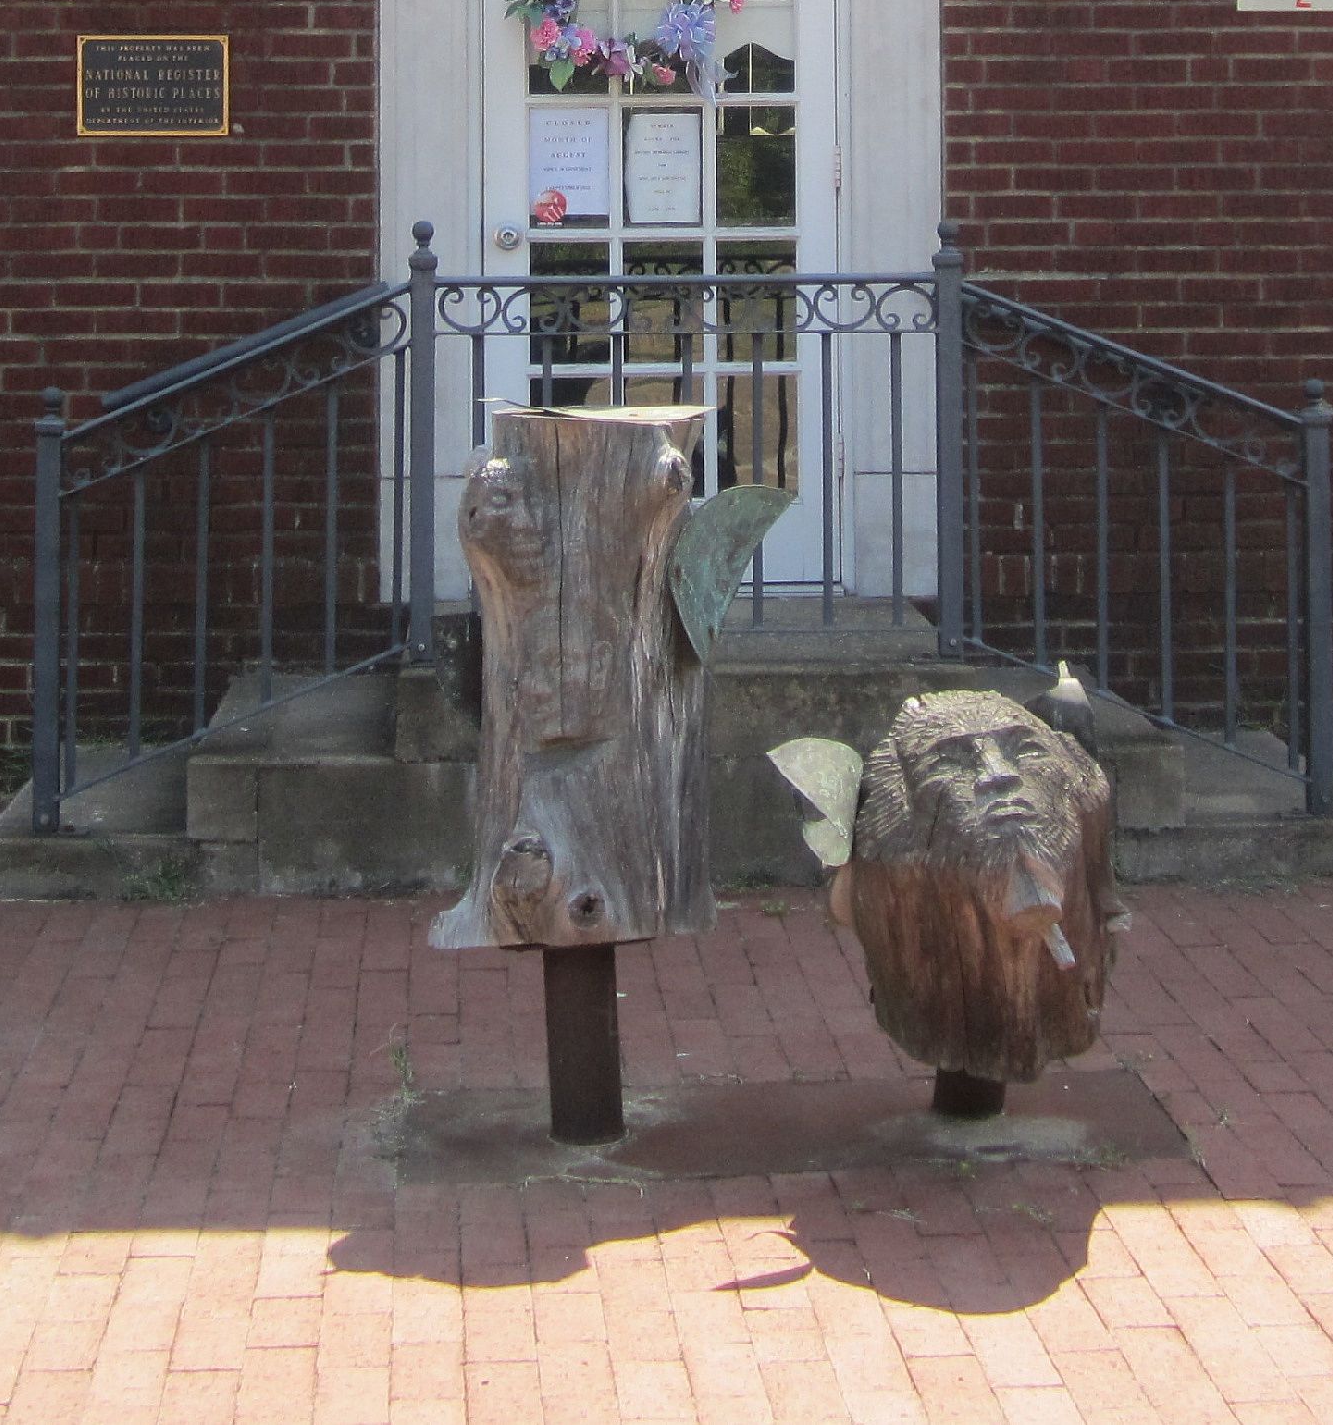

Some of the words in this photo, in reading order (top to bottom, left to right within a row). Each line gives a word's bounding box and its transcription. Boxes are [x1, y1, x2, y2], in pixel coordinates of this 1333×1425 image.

[85, 69, 149, 81] NATIONAL
[158, 69, 221, 81] REGISTER
[85, 87, 101, 99] OF
[108, 87, 165, 99] HISTORIC
[173, 87, 221, 99] PLACES
